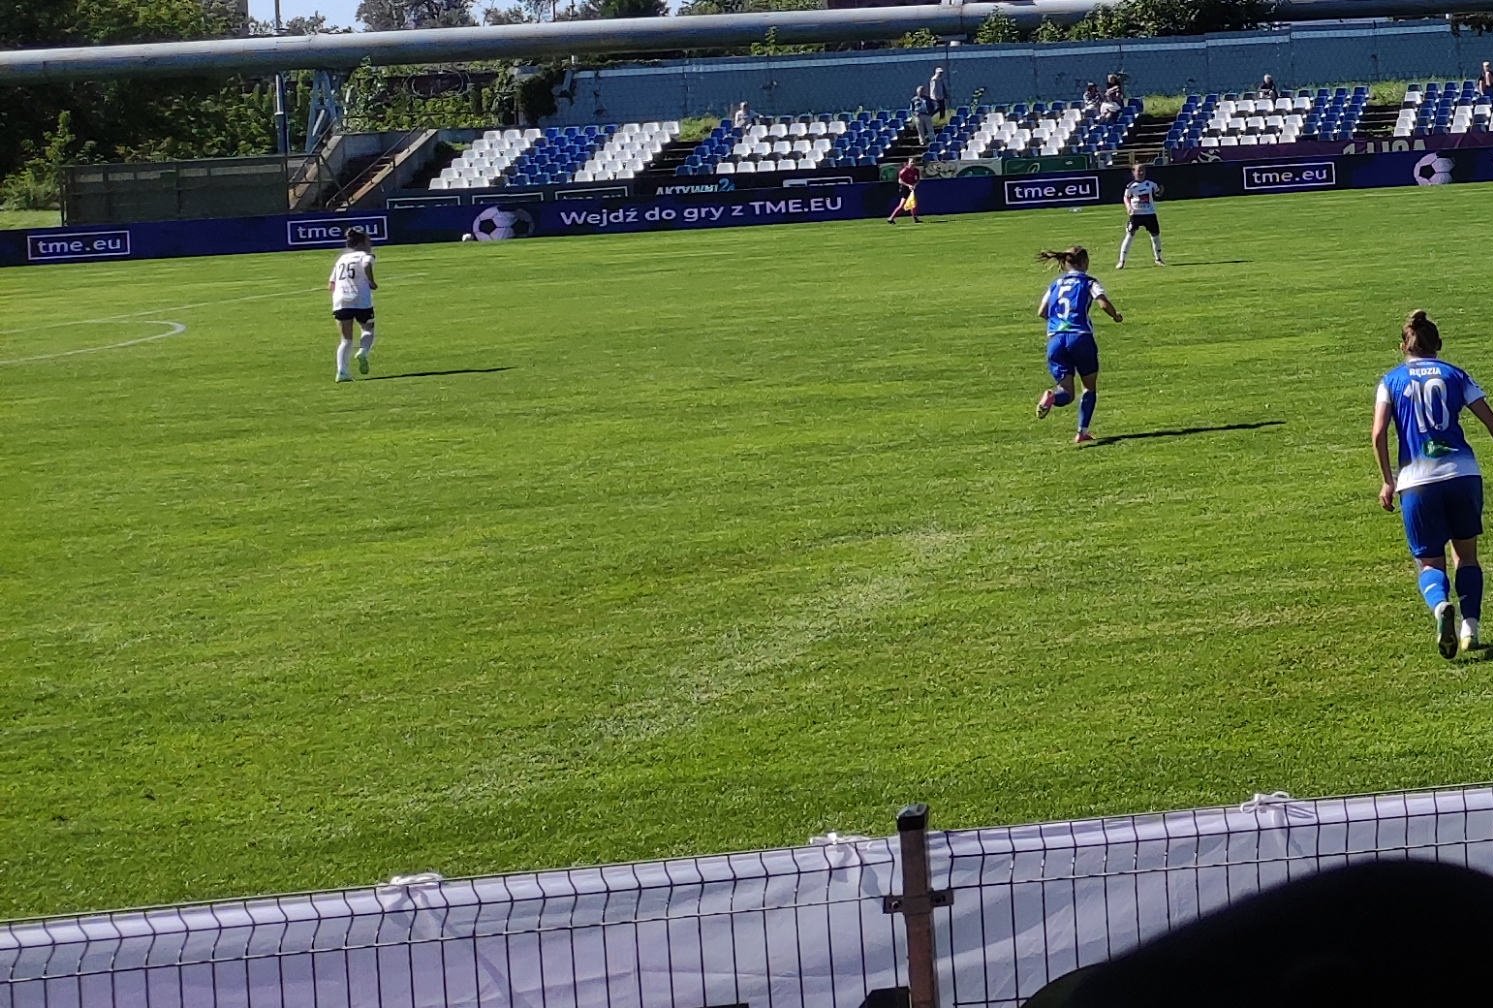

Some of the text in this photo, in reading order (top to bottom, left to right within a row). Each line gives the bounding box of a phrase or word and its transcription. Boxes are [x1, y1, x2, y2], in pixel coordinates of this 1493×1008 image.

[1252, 169, 1327, 184] tme.eu
[1014, 183, 1090, 198] tme.eu
[560, 197, 842, 227] Wejdź do gry z TME.EU
[297, 224, 378, 239] tmeeu
[38, 238, 121, 254] tme.eu
[339, 262, 356, 281] 25
[1056, 285, 1071, 320] 5
[1403, 378, 1450, 433] 10
